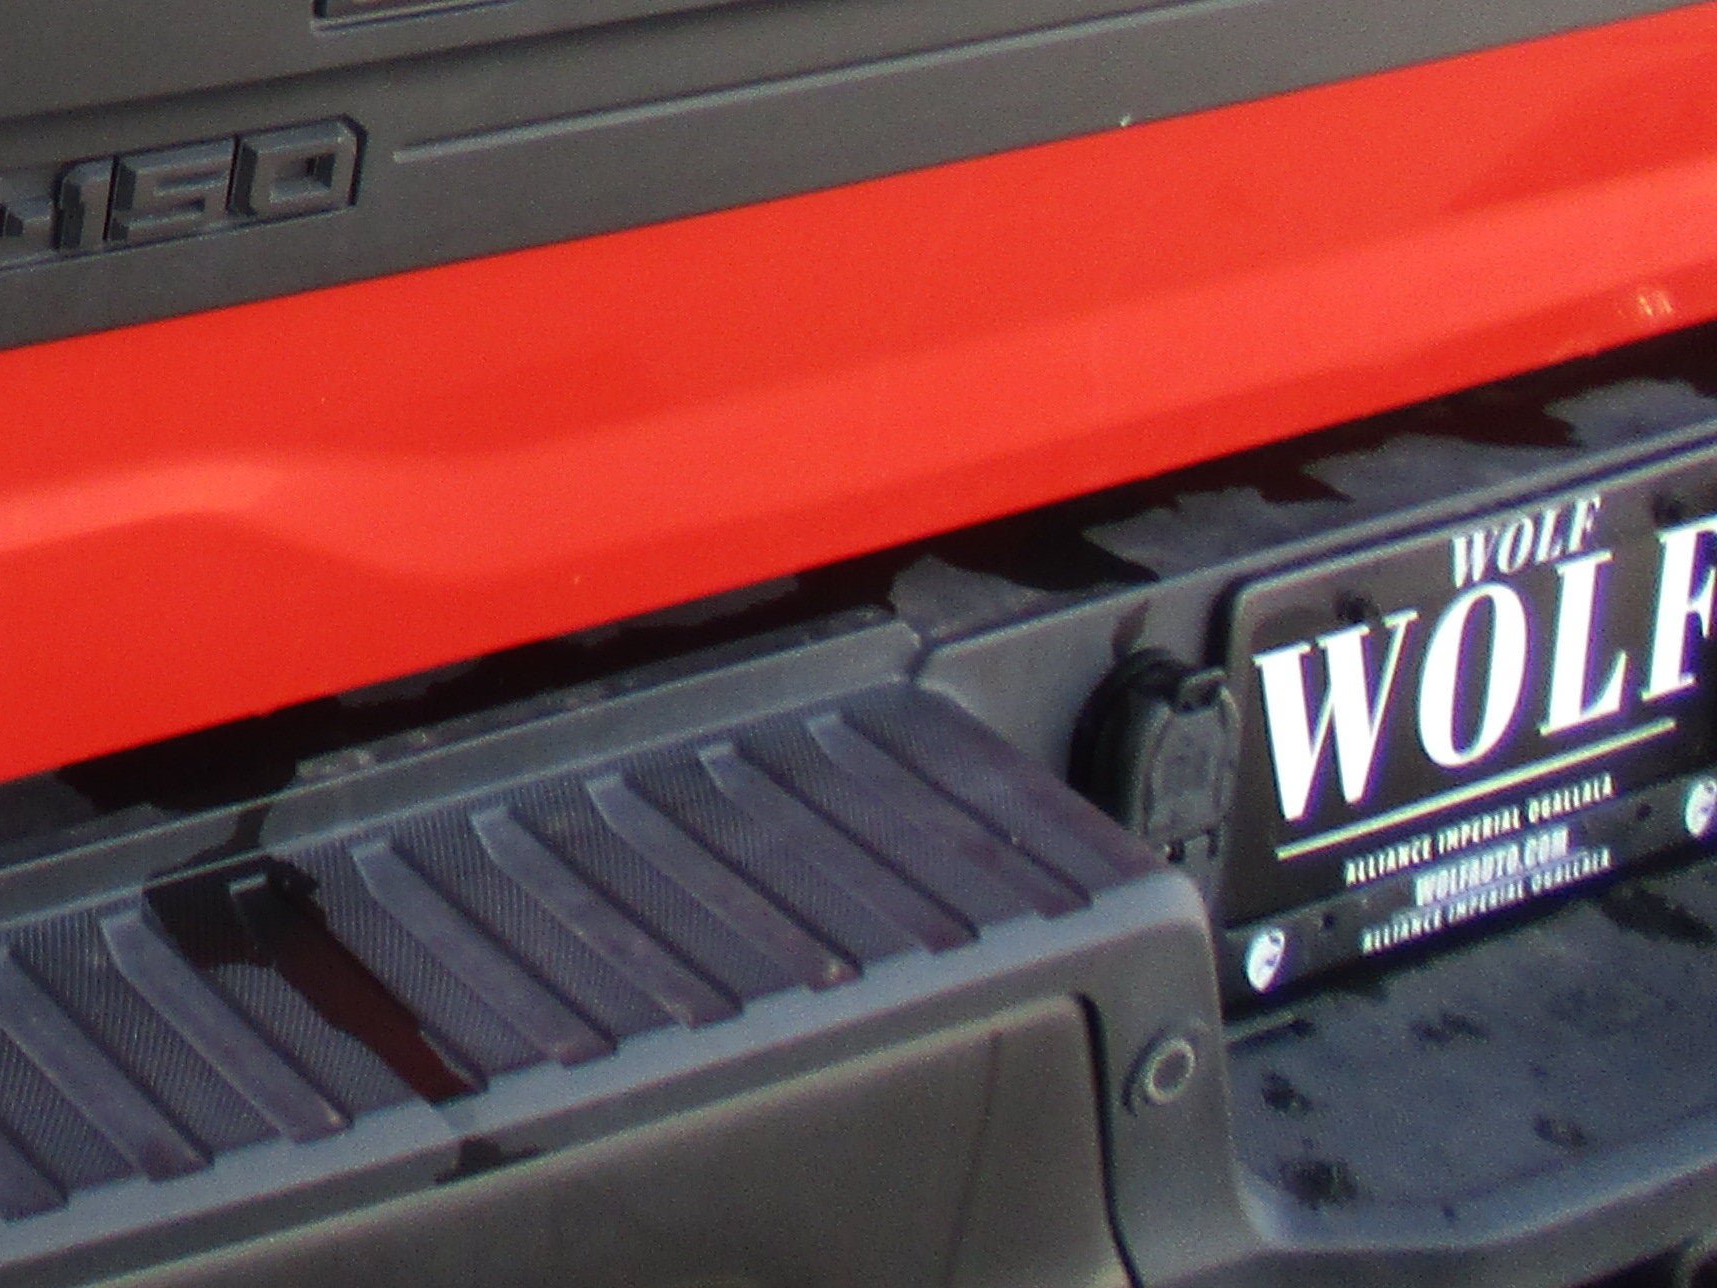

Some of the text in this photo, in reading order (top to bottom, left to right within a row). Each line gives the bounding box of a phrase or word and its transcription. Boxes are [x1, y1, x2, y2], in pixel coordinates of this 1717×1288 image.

[1451, 494, 1601, 588] WOLF
[1252, 517, 1717, 823] WOLF
[1345, 771, 1615, 886] ALLIANCE IMPERIAL OGALLALA
[1362, 906, 1444, 954] ALLIANCE
[1448, 879, 1525, 924] IMPERIAL
